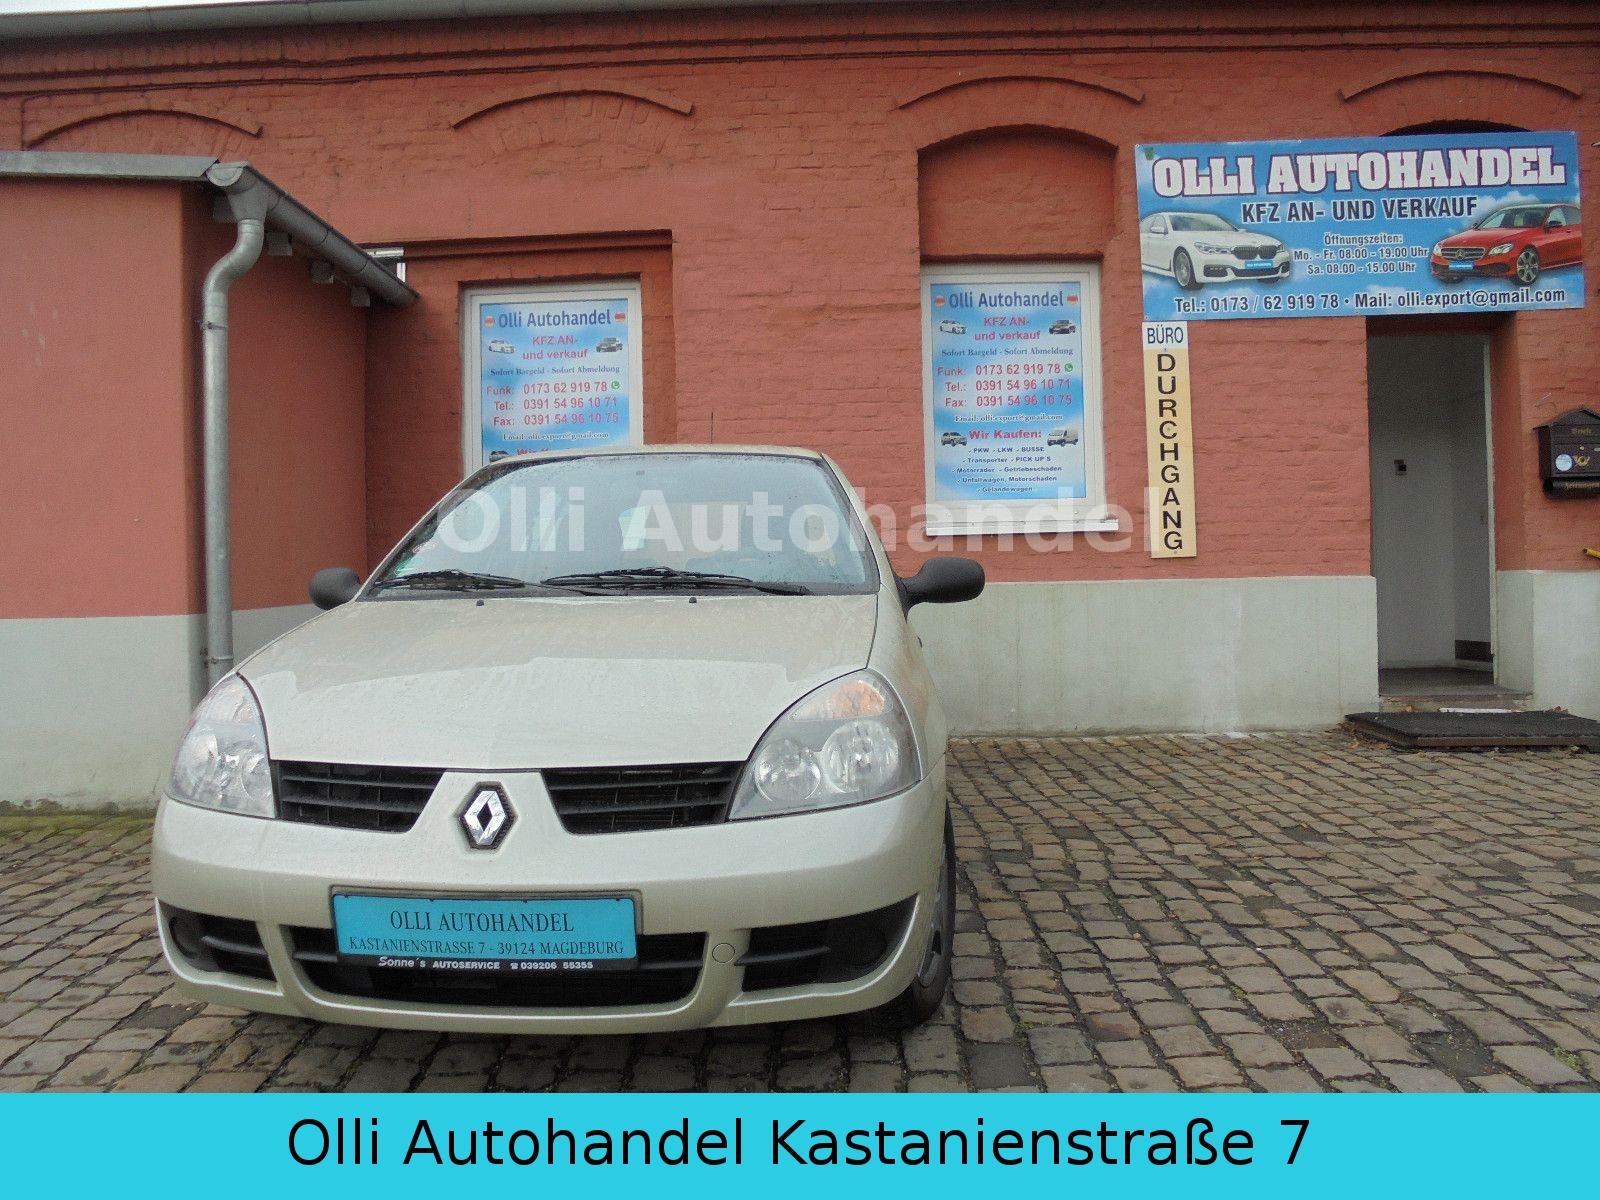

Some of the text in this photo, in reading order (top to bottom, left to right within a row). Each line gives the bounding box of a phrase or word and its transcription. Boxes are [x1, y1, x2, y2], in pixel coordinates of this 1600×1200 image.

[1153, 146, 1567, 197] OLLI AUTOHANDEL
[1241, 196, 1478, 223] KFZ AN- UND VERKAUF
[1324, 232, 1403, 246] Öffnungszeiten:
[1293, 250, 1312, 260] Mo.
[1323, 249, 1335, 260] Fr.
[1339, 248, 1368, 259] 08.00
[1379, 247, 1407, 258] 19.00
[1410, 246, 1429, 257] Uhr
[1307, 264, 1323, 275] Sa.
[1326, 263, 1355, 274] 08.00
[1366, 262, 1395, 273] 15.00
[1398, 261, 1416, 272] Uhr
[950, 290, 1064, 308] Olli Autohandel
[1175, 298, 1206, 313] Tel.:
[1211, 297, 1250, 312] 0173
[1263, 296, 1283, 310] 62
[1287, 295, 1316, 310] 919
[1321, 294, 1340, 309] 78
[1355, 293, 1392, 308] Mail:
[1396, 289, 1566, 308] olli.export@gmail.com
[498, 309, 612, 328] Olli Autohandel
[983, 316, 1030, 327] KFZ AN-
[532, 335, 556, 345] KFZ
[974, 330, 1041, 341] und verkauf
[1146, 324, 1184, 345] BÜRO
[522, 349, 589, 360] und verkauf
[941, 349, 965, 357] Sofort
[968, 348, 997, 357] Bargeld
[1004, 347, 1028, 356] Sofort
[1030, 347, 1073, 356] Abmeldung
[937, 363, 1061, 376] Funk: 0173 62 919 78
[524, 382, 550, 394] 0173
[553, 382, 567, 393] 62
[571, 381, 591, 393] 919
[594, 381, 608, 392] 78
[945, 378, 1072, 392] Tel.: 0391 54 96 10 71
[493, 397, 617, 411] Tel.: 0391 54 96 10 71
[945, 394, 1072, 407] Fax: 0391 54 96 10 75
[493, 416, 515, 427] Fax:
[524, 414, 550, 425] 0391
[554, 414, 567, 425] 54
[571, 414, 584, 425] 96
[589, 413, 600, 424] 10
[969, 430, 1042, 440] Wir Kaufen:
[1156, 352, 1183, 551] DURCHGANG
[968, 456, 1008, 464] Transporter
[390, 910, 574, 932] OLLI AUTOHANDEL
[348, 936, 475, 954] KASTANIENSTRASSE
[479, 942, 485, 953] 7
[497, 942, 536, 955] 39124
[540, 941, 624, 955] MAGDEBURG
[432, 960, 501, 970] AUTOSERVICE
[520, 961, 557, 970] 039206
[563, 961, 594, 969] 55355
